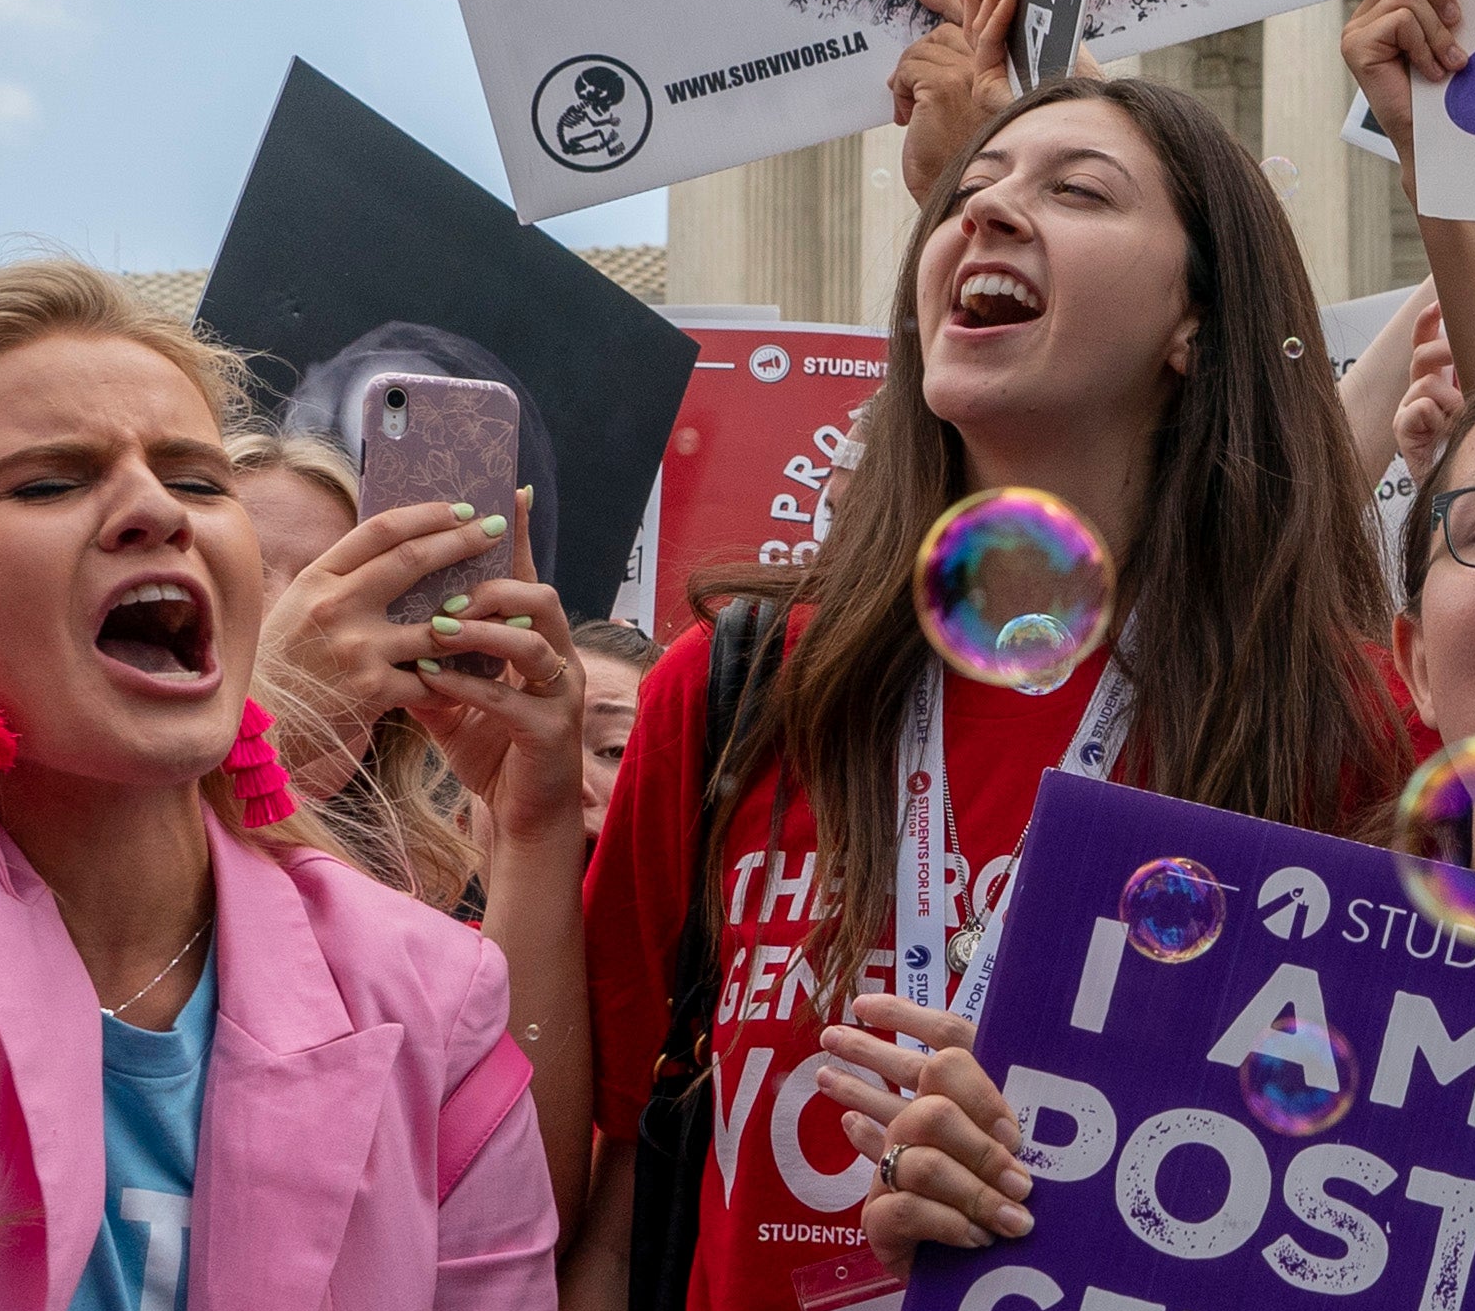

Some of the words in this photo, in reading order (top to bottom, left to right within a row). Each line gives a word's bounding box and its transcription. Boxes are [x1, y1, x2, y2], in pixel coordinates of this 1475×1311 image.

[664, 30, 869, 105] WWW.SURVIVORS.LA
[909, 797, 917, 837] ACTION
[918, 796, 930, 858] STUDENTS
[918, 861, 930, 885] FOR
[918, 887, 930, 917] LIFE
[1070, 917, 1129, 1034] I
[966, 983, 986, 1011] FOR
